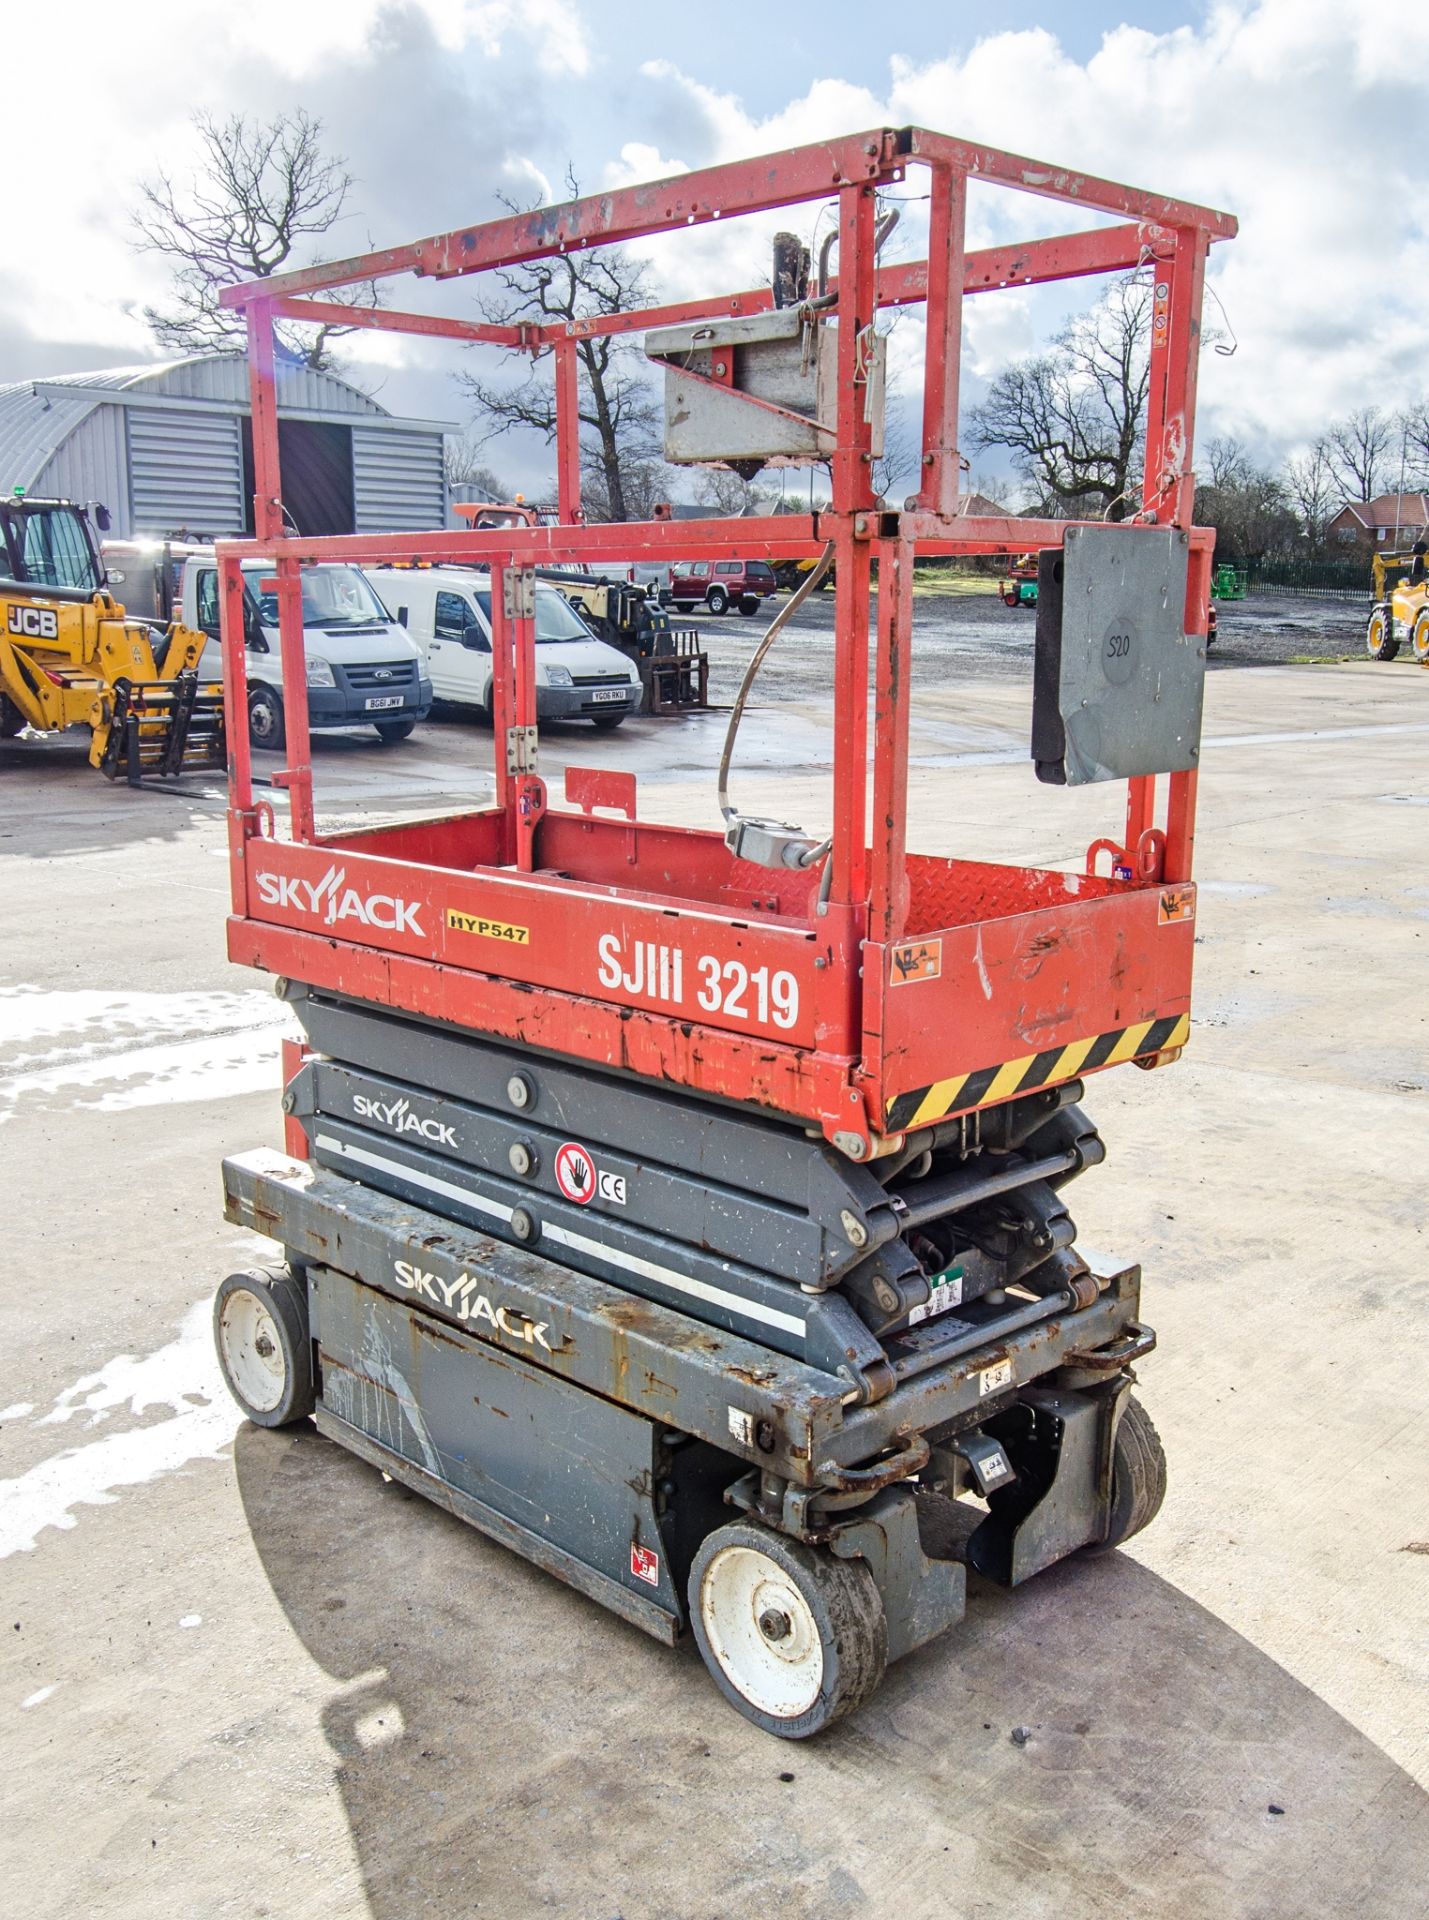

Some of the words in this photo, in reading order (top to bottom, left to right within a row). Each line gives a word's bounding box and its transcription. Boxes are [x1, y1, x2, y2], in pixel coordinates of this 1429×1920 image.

[9, 607, 58, 638] JCB
[611, 690, 624, 699] RKU
[256, 864, 426, 937] SKYJACK
[450, 915, 527, 941] HYP547
[697, 955, 799, 1029] 3219
[353, 1094, 458, 1148] SKYJACK
[601, 1174, 624, 1200] CE
[394, 1260, 552, 1352] SKYJACK
